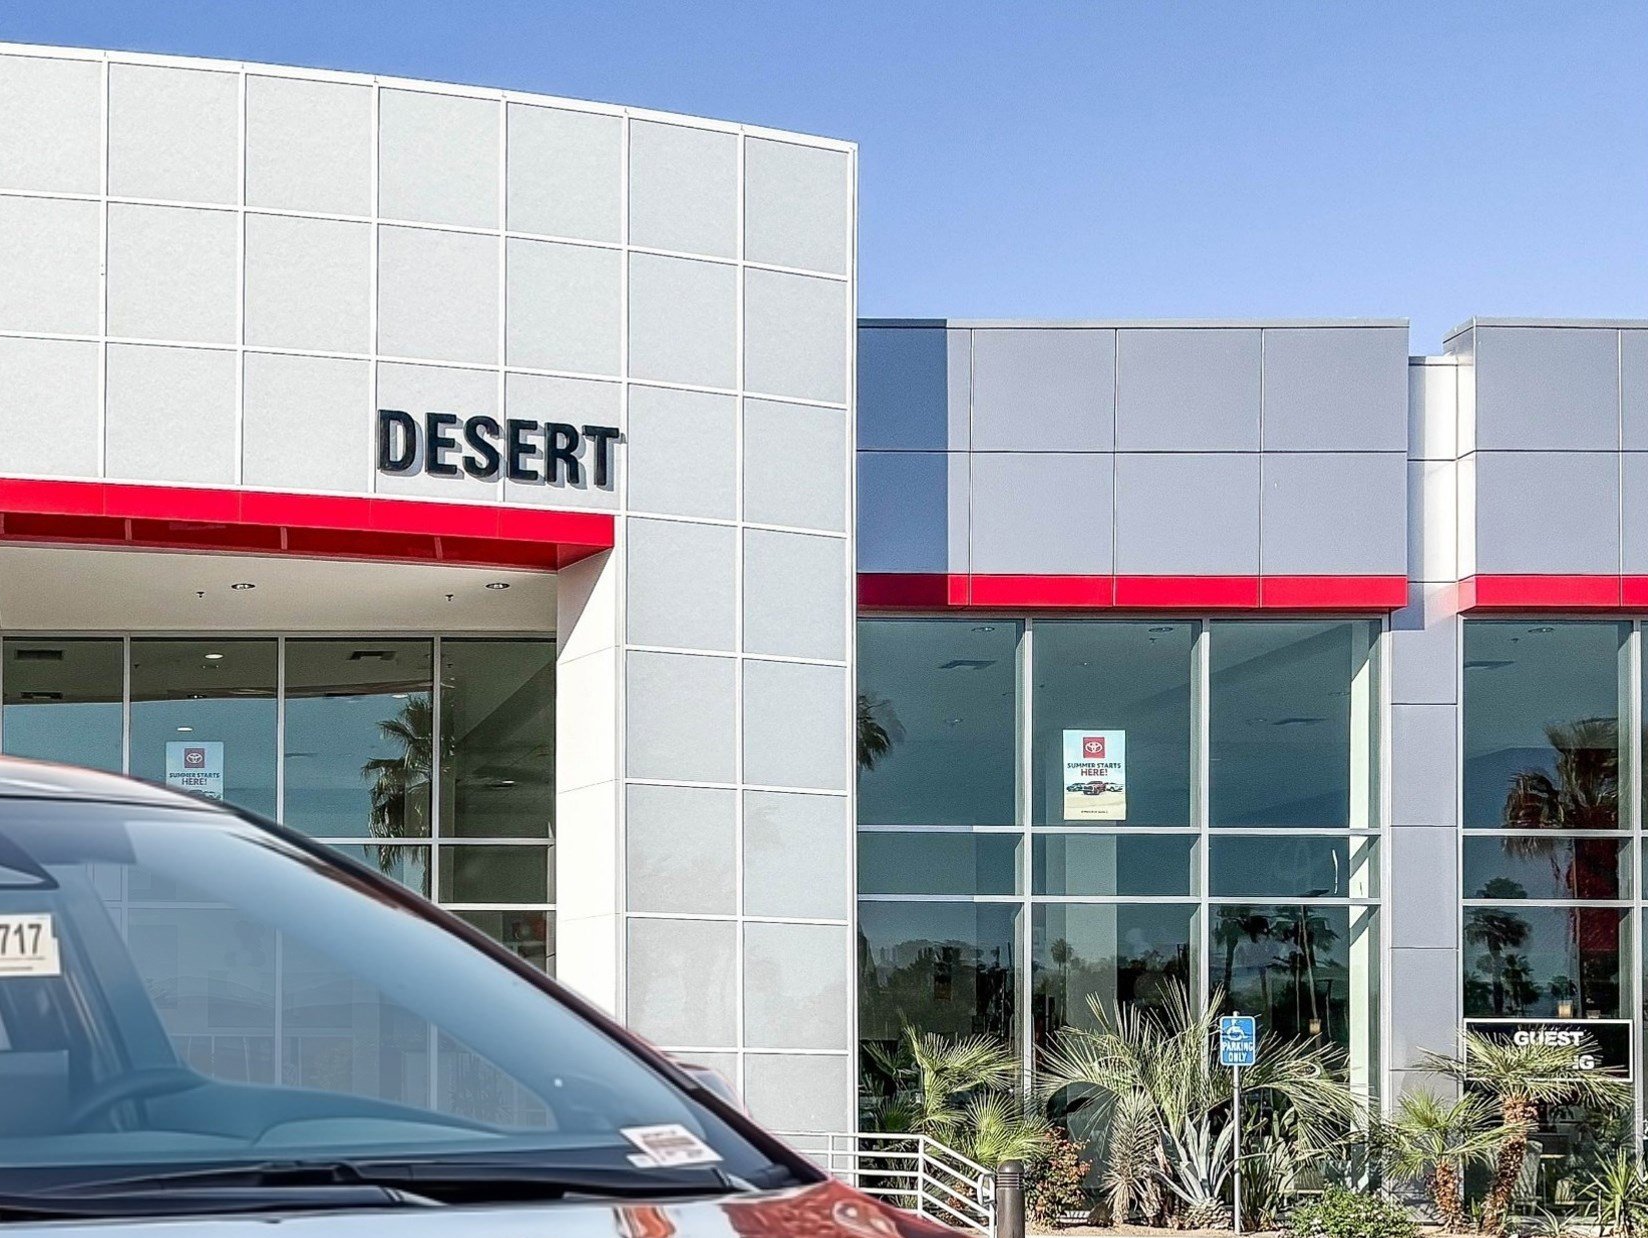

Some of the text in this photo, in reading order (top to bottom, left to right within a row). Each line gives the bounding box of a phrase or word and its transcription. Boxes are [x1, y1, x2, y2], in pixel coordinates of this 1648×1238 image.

[377, 409, 620, 487] DESERT
[1081, 768, 1108, 777] HERE!
[181, 778, 208, 786] HERE!
[1513, 1030, 1585, 1047] GUEST
[1222, 1041, 1253, 1052] PARKING
[1228, 1052, 1247, 1062] ONLY
